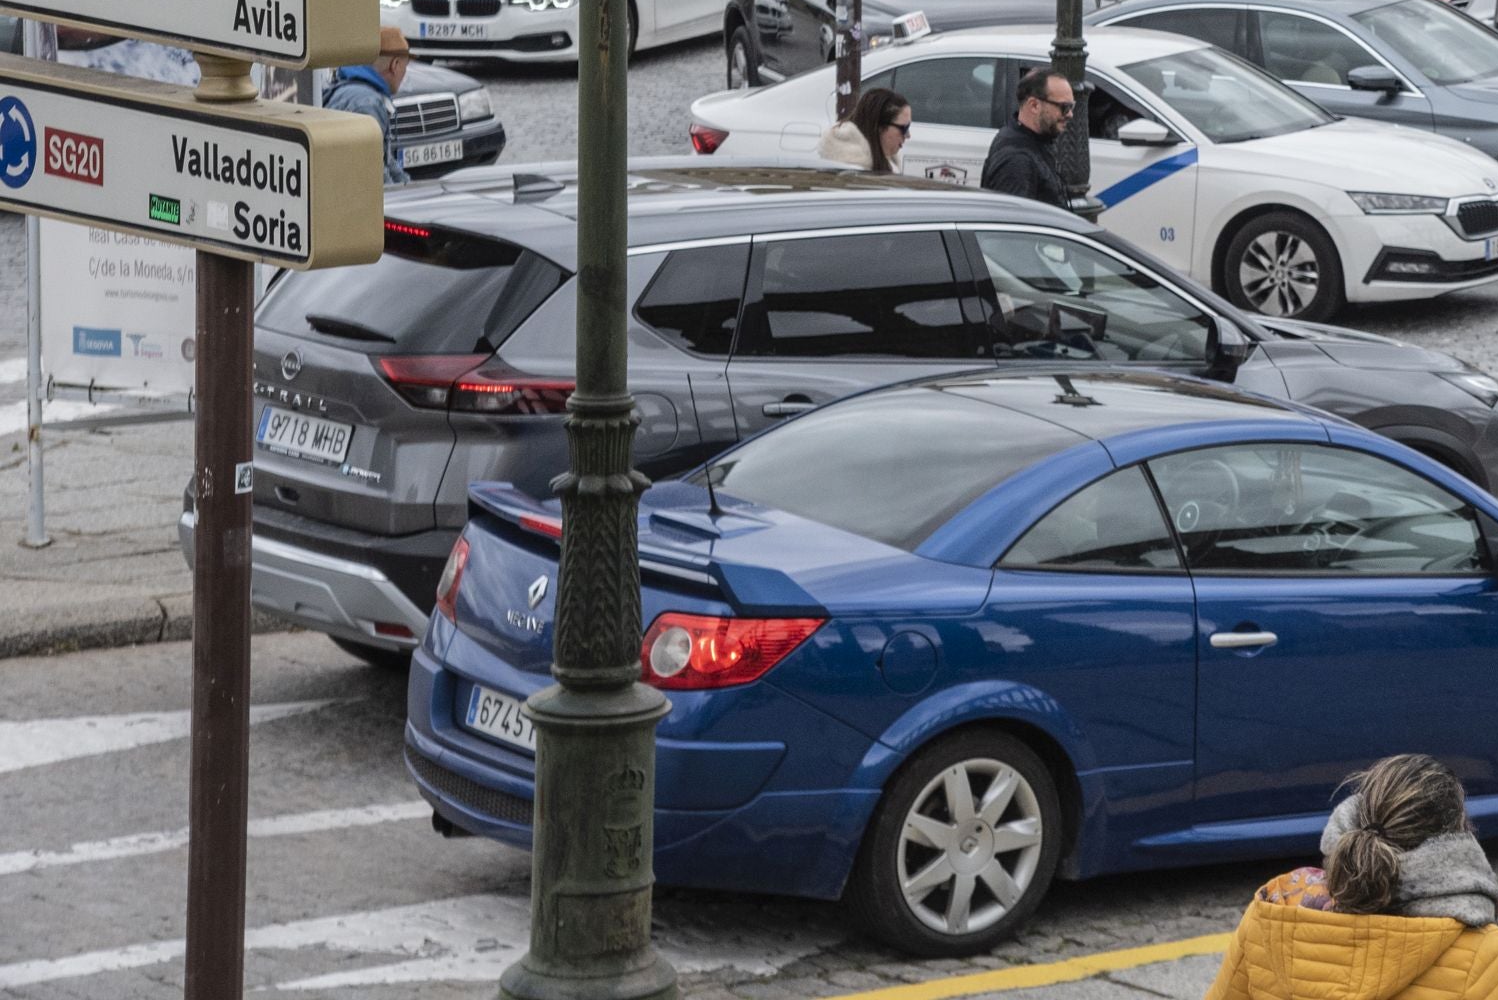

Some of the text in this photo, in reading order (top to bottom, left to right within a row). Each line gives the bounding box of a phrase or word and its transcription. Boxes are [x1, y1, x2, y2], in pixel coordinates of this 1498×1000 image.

[428, 25, 484, 37] 8287 MCH
[49, 135, 100, 179] SG20
[172, 134, 301, 198] Valladolid
[404, 149, 420, 164] SG
[454, 145, 461, 157] H
[233, 201, 302, 252] Soria
[1160, 227, 1175, 242] 03
[119, 260, 130, 277] la
[269, 414, 310, 446] 9718
[311, 423, 346, 455] MHB
[479, 695, 524, 738] 6745
